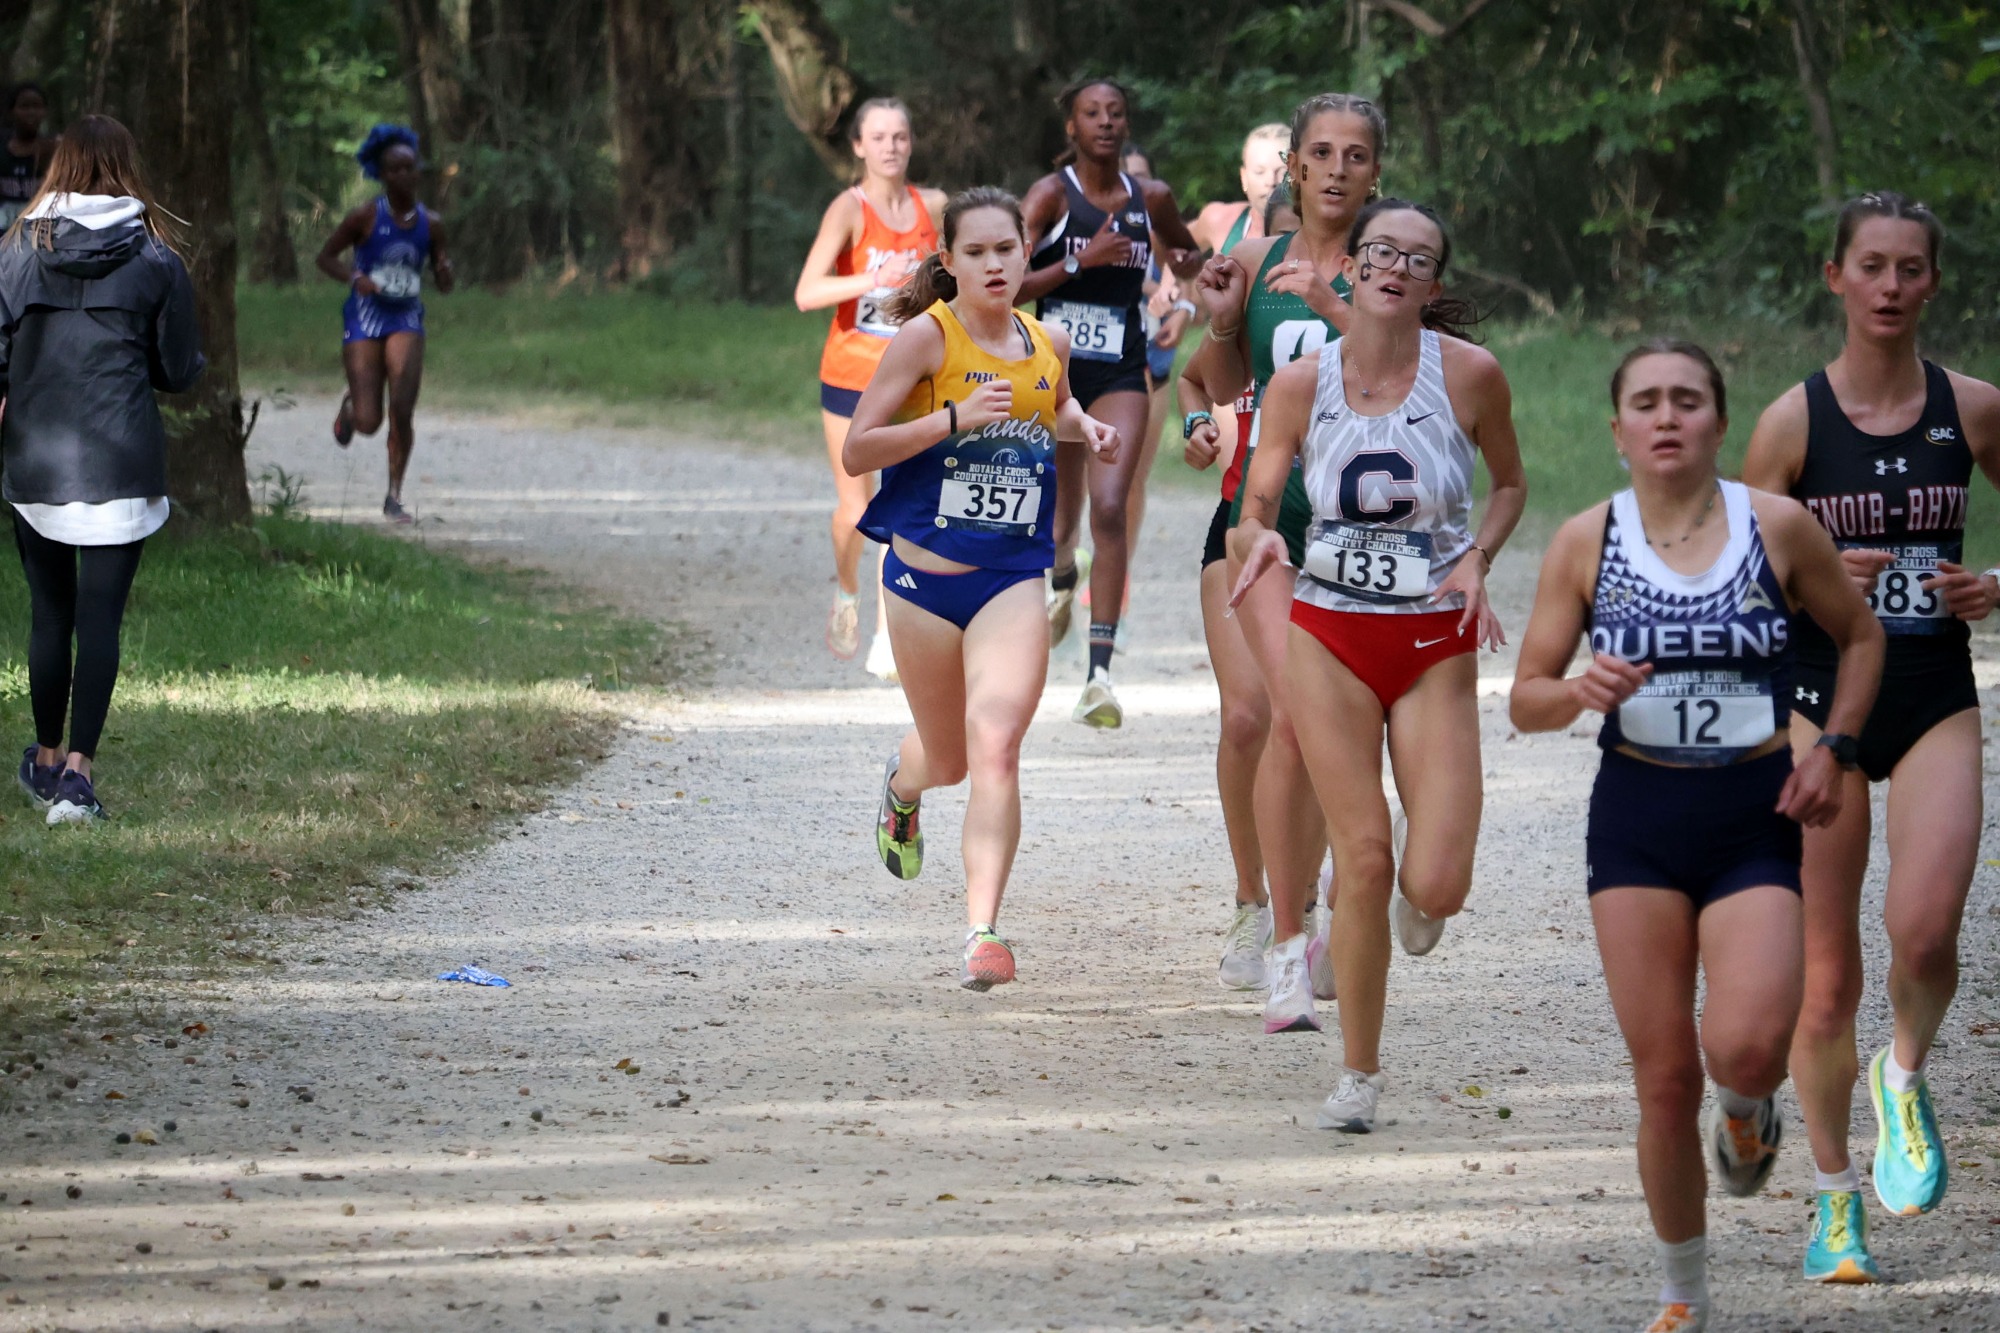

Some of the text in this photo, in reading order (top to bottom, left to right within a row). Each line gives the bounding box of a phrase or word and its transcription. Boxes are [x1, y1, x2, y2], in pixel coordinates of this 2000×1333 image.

[1320, 412, 1340, 421] SAC
[956, 410, 1051, 450] Lander
[1930, 427, 1955, 440] SAC
[954, 471, 1038, 486] COUNTRY CHALLENGE
[969, 464, 1031, 477] ROYALS CROSS
[1337, 449, 1418, 526] C
[963, 484, 1027, 521] 357
[1323, 532, 1421, 557] COUNTRY CHALLENGE
[1337, 525, 1408, 544] ROYALS CROSS
[1904, 547, 1938, 558] CROSS
[1335, 549, 1398, 592] 133
[1866, 572, 1938, 616] 83
[1592, 618, 1787, 662] QUEENS
[1653, 671, 1742, 685] ROYALS CROSS
[1694, 683, 1760, 696] CHALLENGE
[1673, 699, 1722, 744] 12
